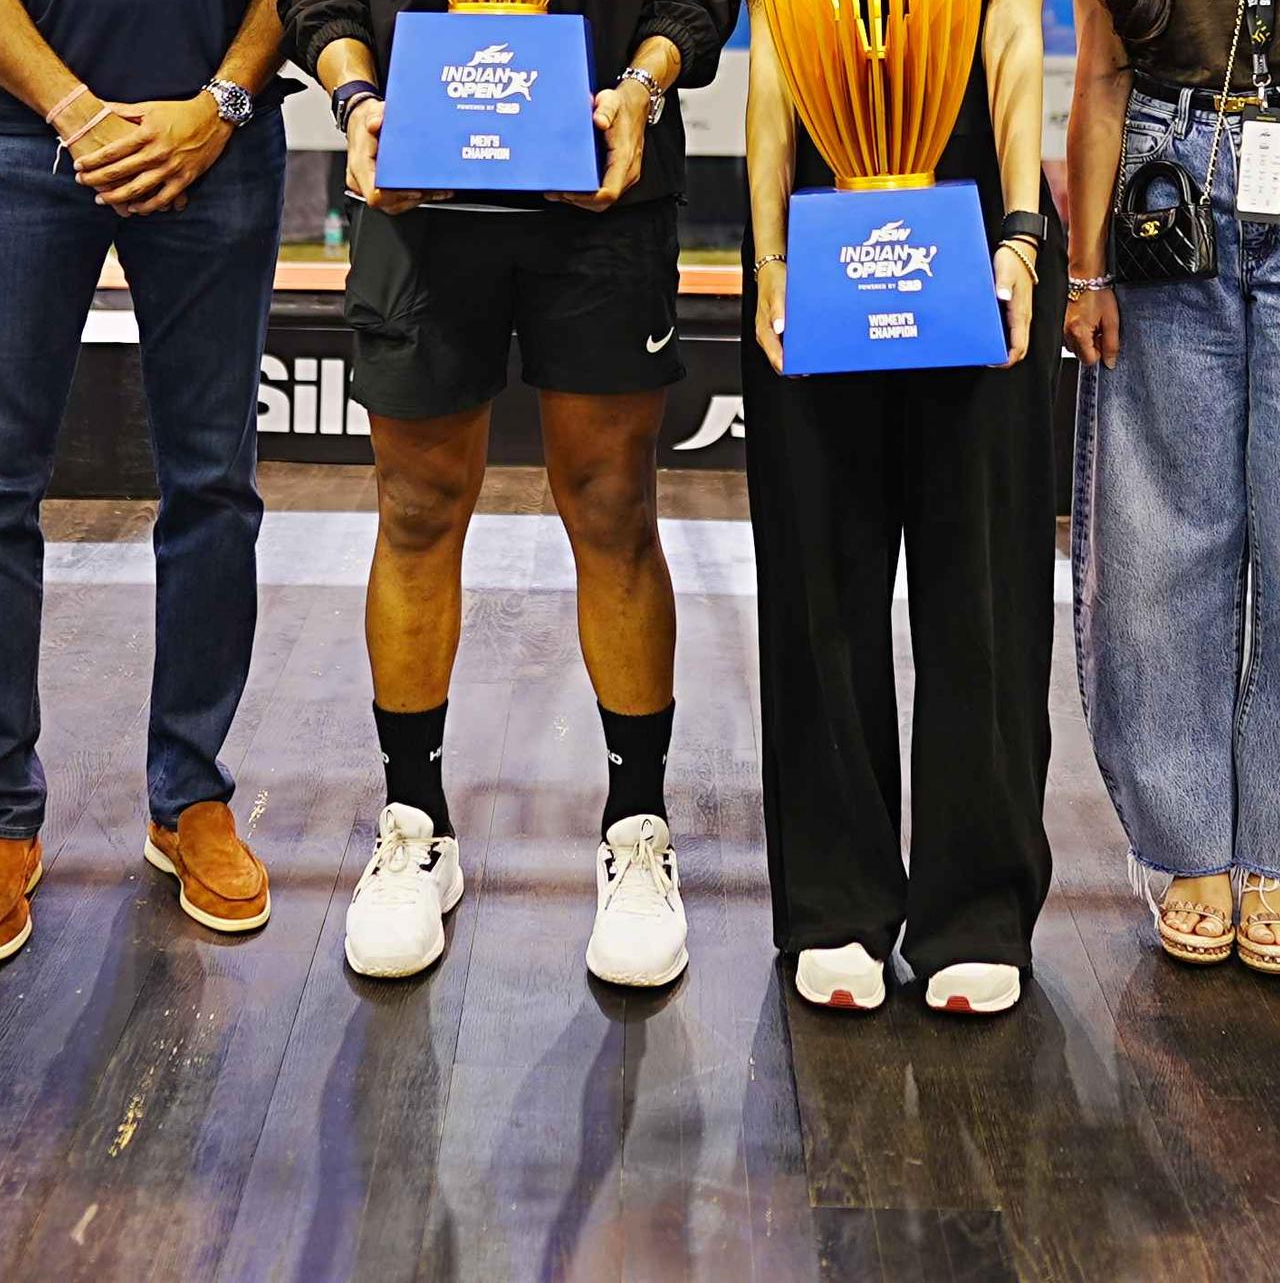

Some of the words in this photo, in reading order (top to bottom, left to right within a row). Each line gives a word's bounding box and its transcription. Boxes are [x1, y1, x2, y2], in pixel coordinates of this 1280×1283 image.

[441, 65, 511, 83] INDIAN
[447, 82, 504, 99] OPEN
[462, 146, 510, 160] CHAMPION
[840, 245, 909, 263] INDIAN
[846, 261, 904, 279] OPEN
[868, 312, 915, 327] WOMEN'S
[869, 325, 918, 339] CHAMPION
